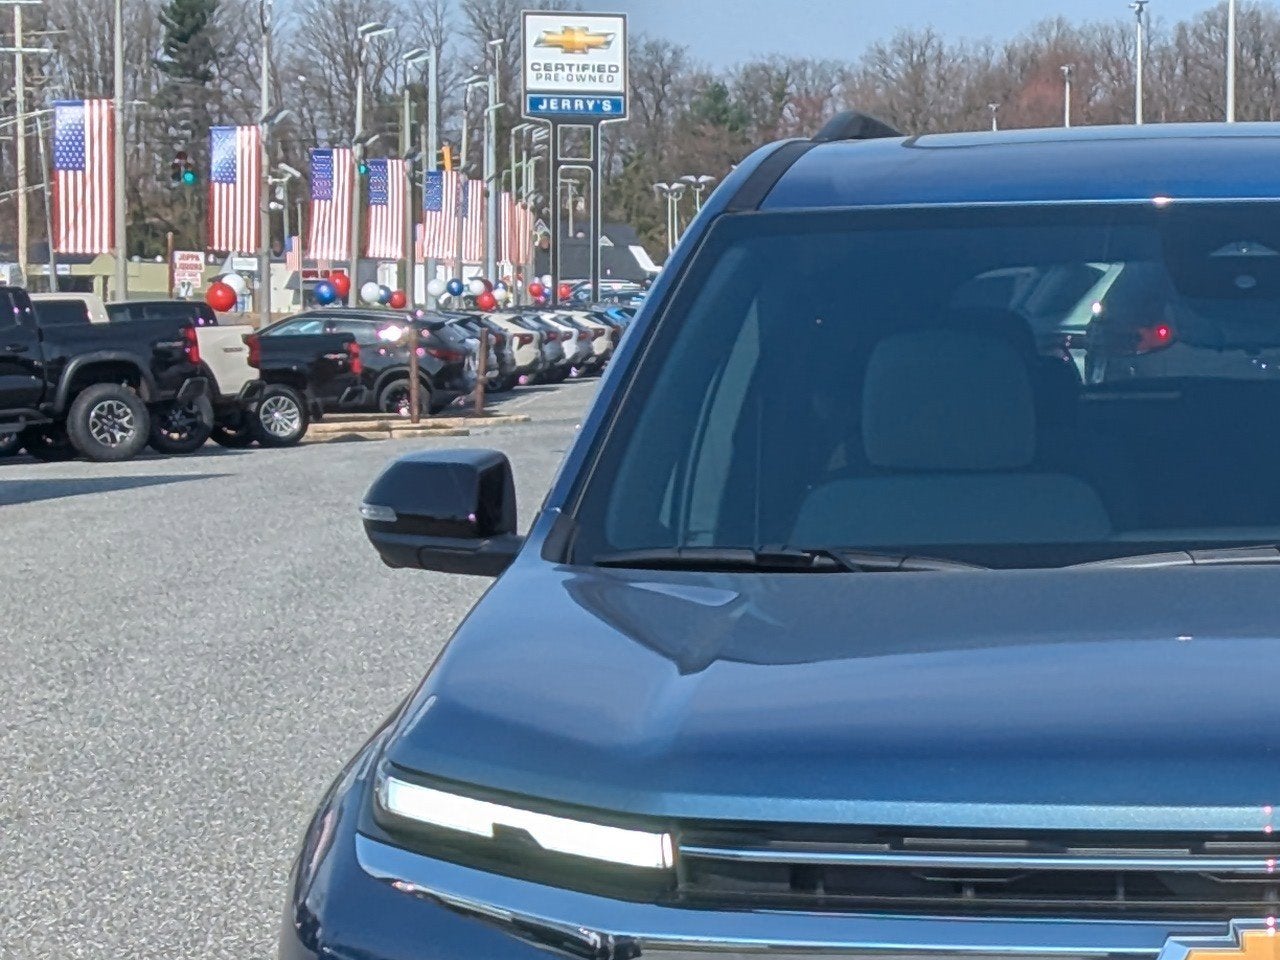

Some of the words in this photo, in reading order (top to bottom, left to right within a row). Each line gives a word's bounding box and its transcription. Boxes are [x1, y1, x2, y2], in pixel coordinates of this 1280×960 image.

[530, 62, 620, 74] CERTIFIED
[535, 73, 615, 83] PRE-OWNED
[538, 98, 612, 112] JERRY'S
